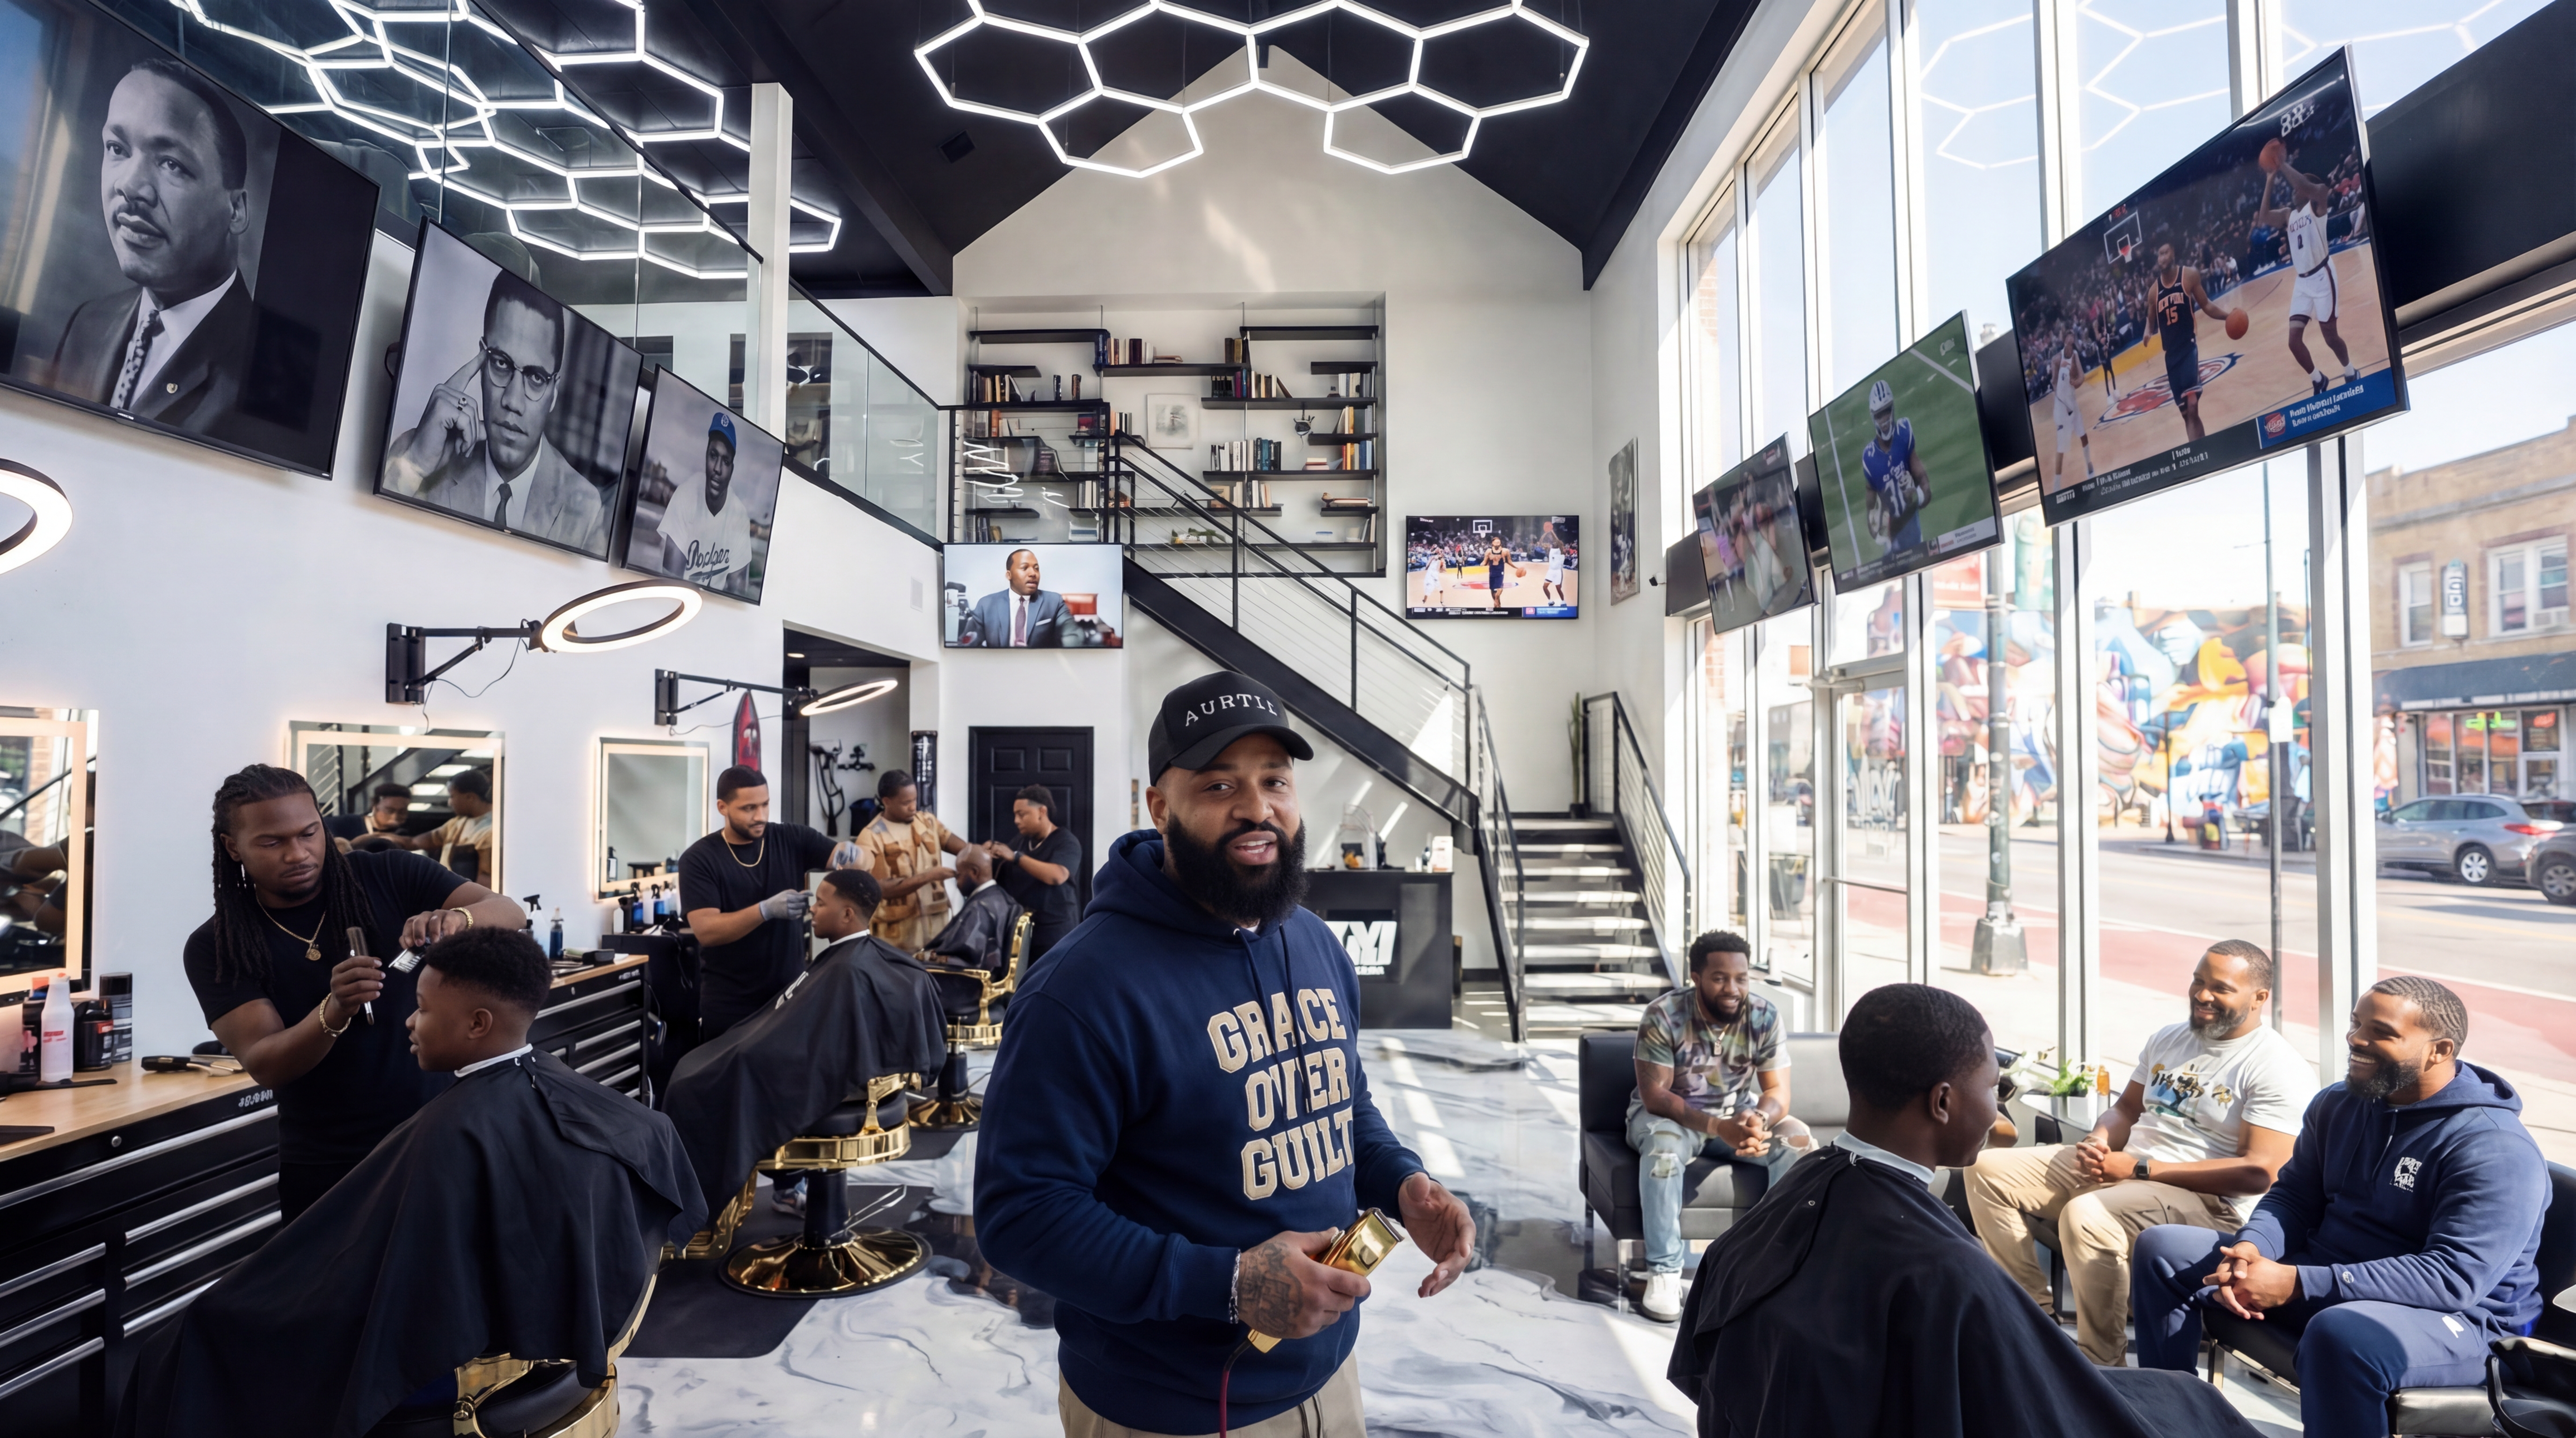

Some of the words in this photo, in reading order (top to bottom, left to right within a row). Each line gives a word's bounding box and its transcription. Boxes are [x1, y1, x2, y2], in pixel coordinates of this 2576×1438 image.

[2166, 305, 2178, 326] 15
[1207, 989, 1347, 1073] GRACE
[1245, 1047, 1350, 1131] OVER
[1241, 1105, 1353, 1201] GUILT
